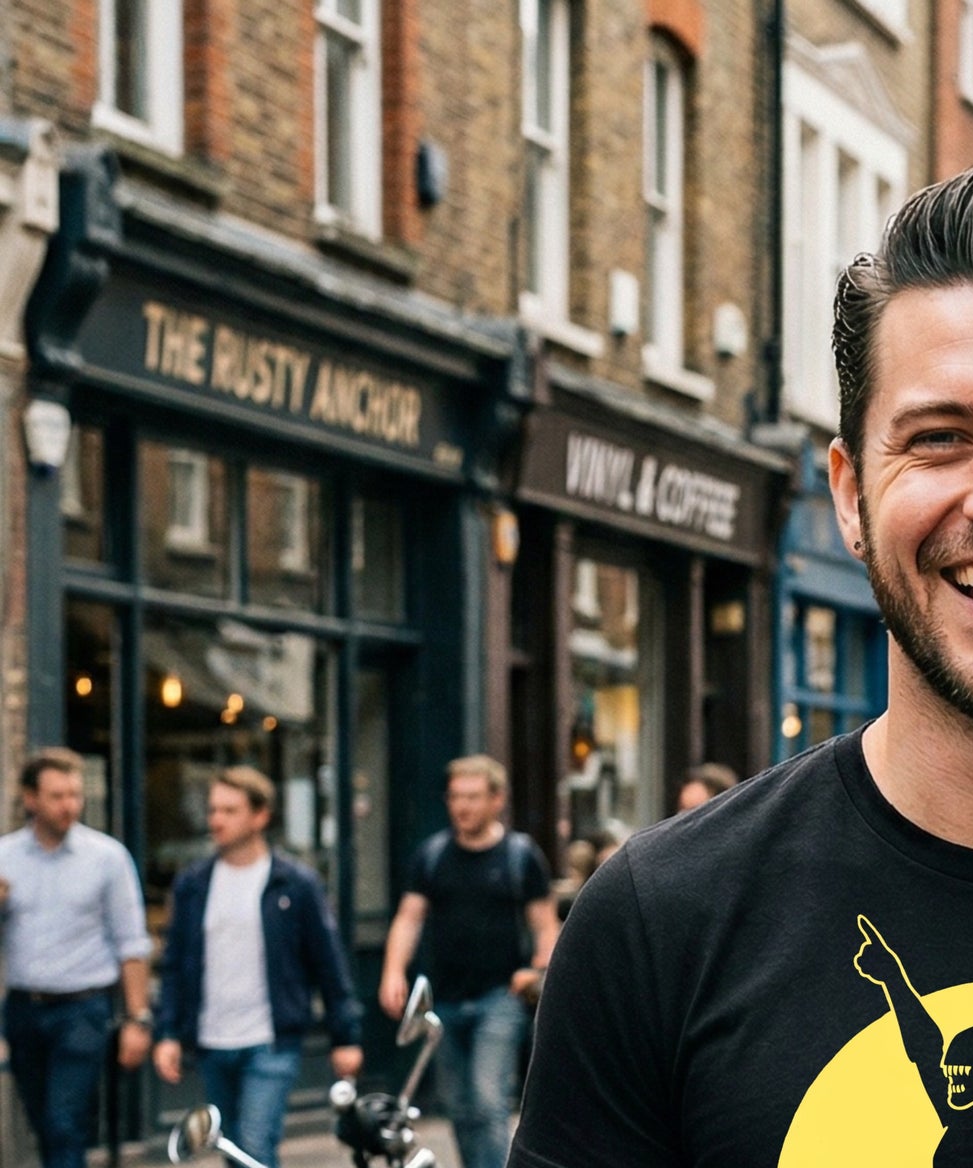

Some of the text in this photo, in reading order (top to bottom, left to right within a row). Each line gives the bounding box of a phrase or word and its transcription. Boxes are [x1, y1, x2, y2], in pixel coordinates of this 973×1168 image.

[143, 301, 422, 446] THE RUSTY ANCHOR
[635, 455, 658, 516] &
[656, 464, 741, 541] COFFEE
